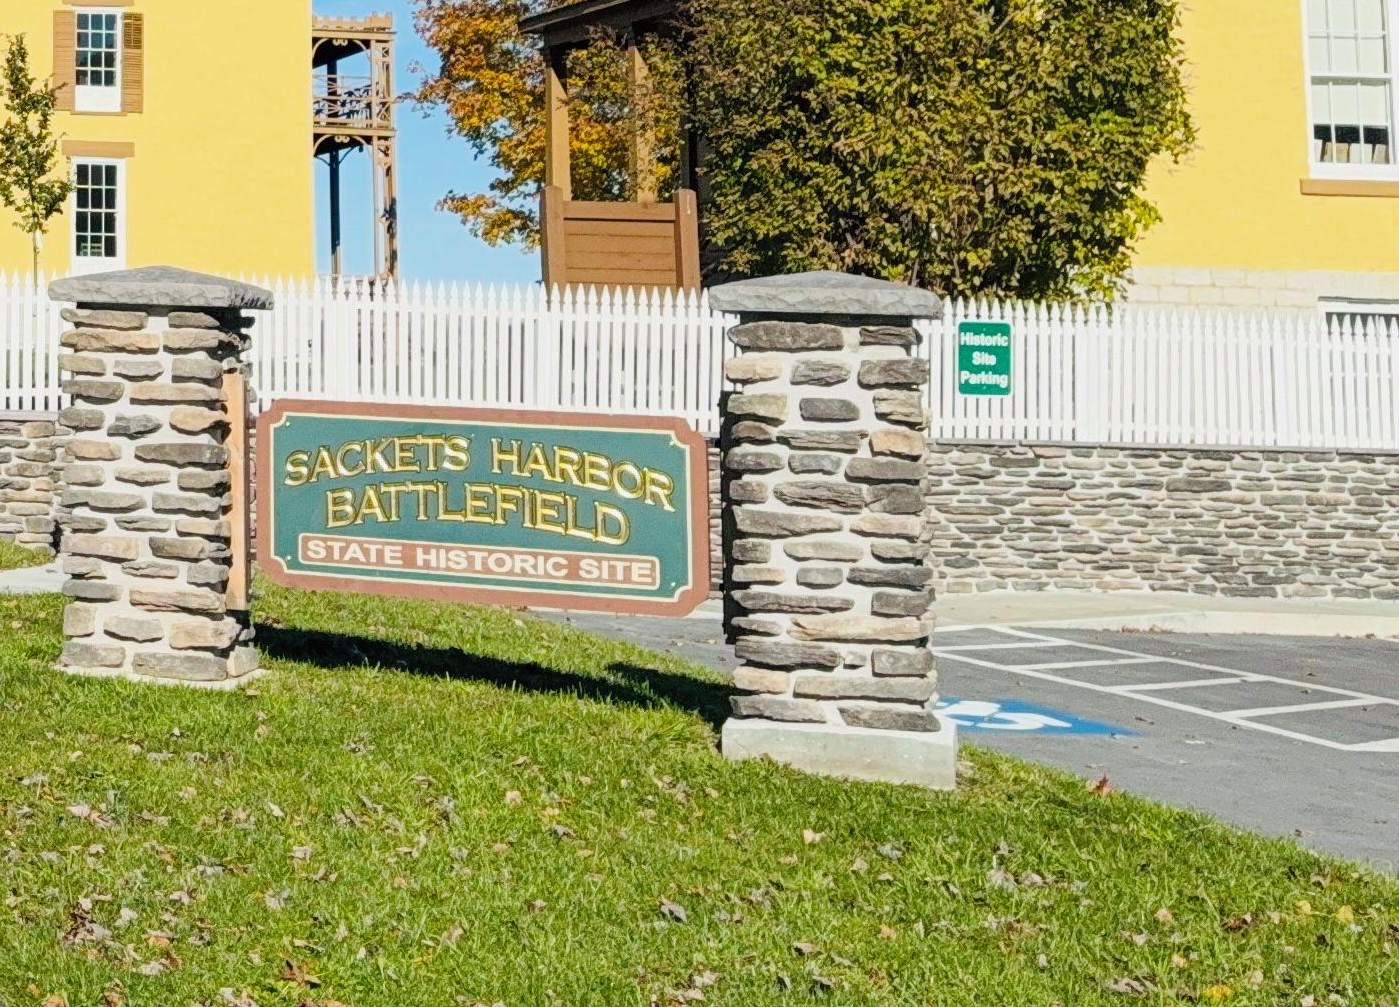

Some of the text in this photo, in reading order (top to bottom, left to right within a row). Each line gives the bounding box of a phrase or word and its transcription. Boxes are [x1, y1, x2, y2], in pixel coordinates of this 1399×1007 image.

[960, 332, 1009, 347] Historic
[971, 351, 997, 366] Site
[960, 370, 1008, 389] Parking
[284, 433, 676, 512] SACKETS HARBOR
[326, 480, 631, 545] BATTLEFIELD
[307, 540, 653, 583] STATE HISTORIC SITE
